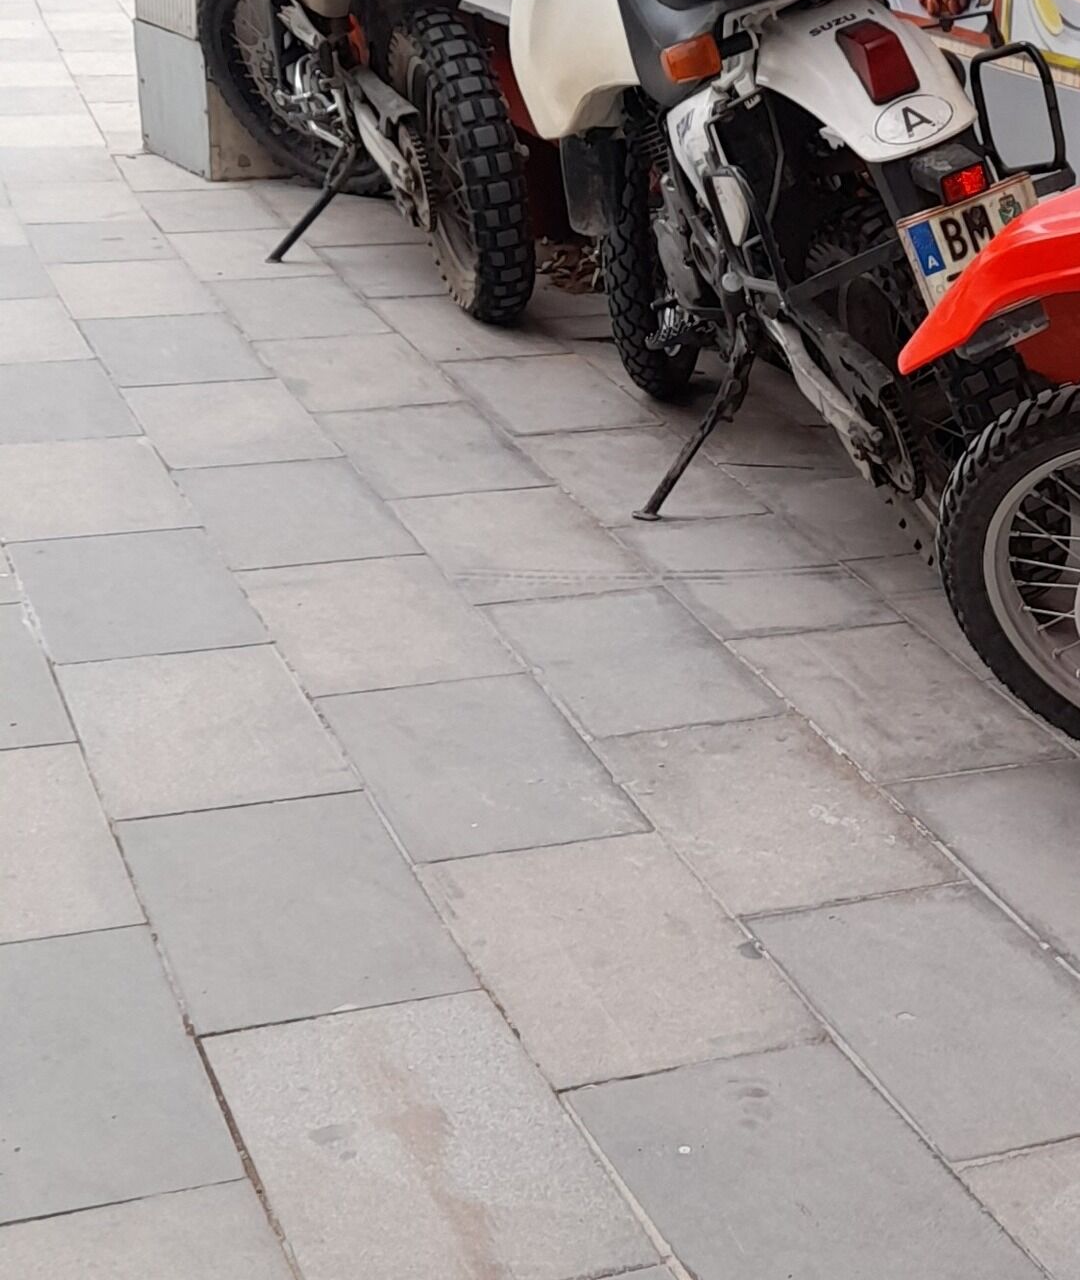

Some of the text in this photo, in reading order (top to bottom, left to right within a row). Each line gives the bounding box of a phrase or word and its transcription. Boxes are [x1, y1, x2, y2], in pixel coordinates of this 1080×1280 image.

[901, 105, 935, 138] A
[939, 204, 995, 262] BM
[927, 255, 940, 270] A
